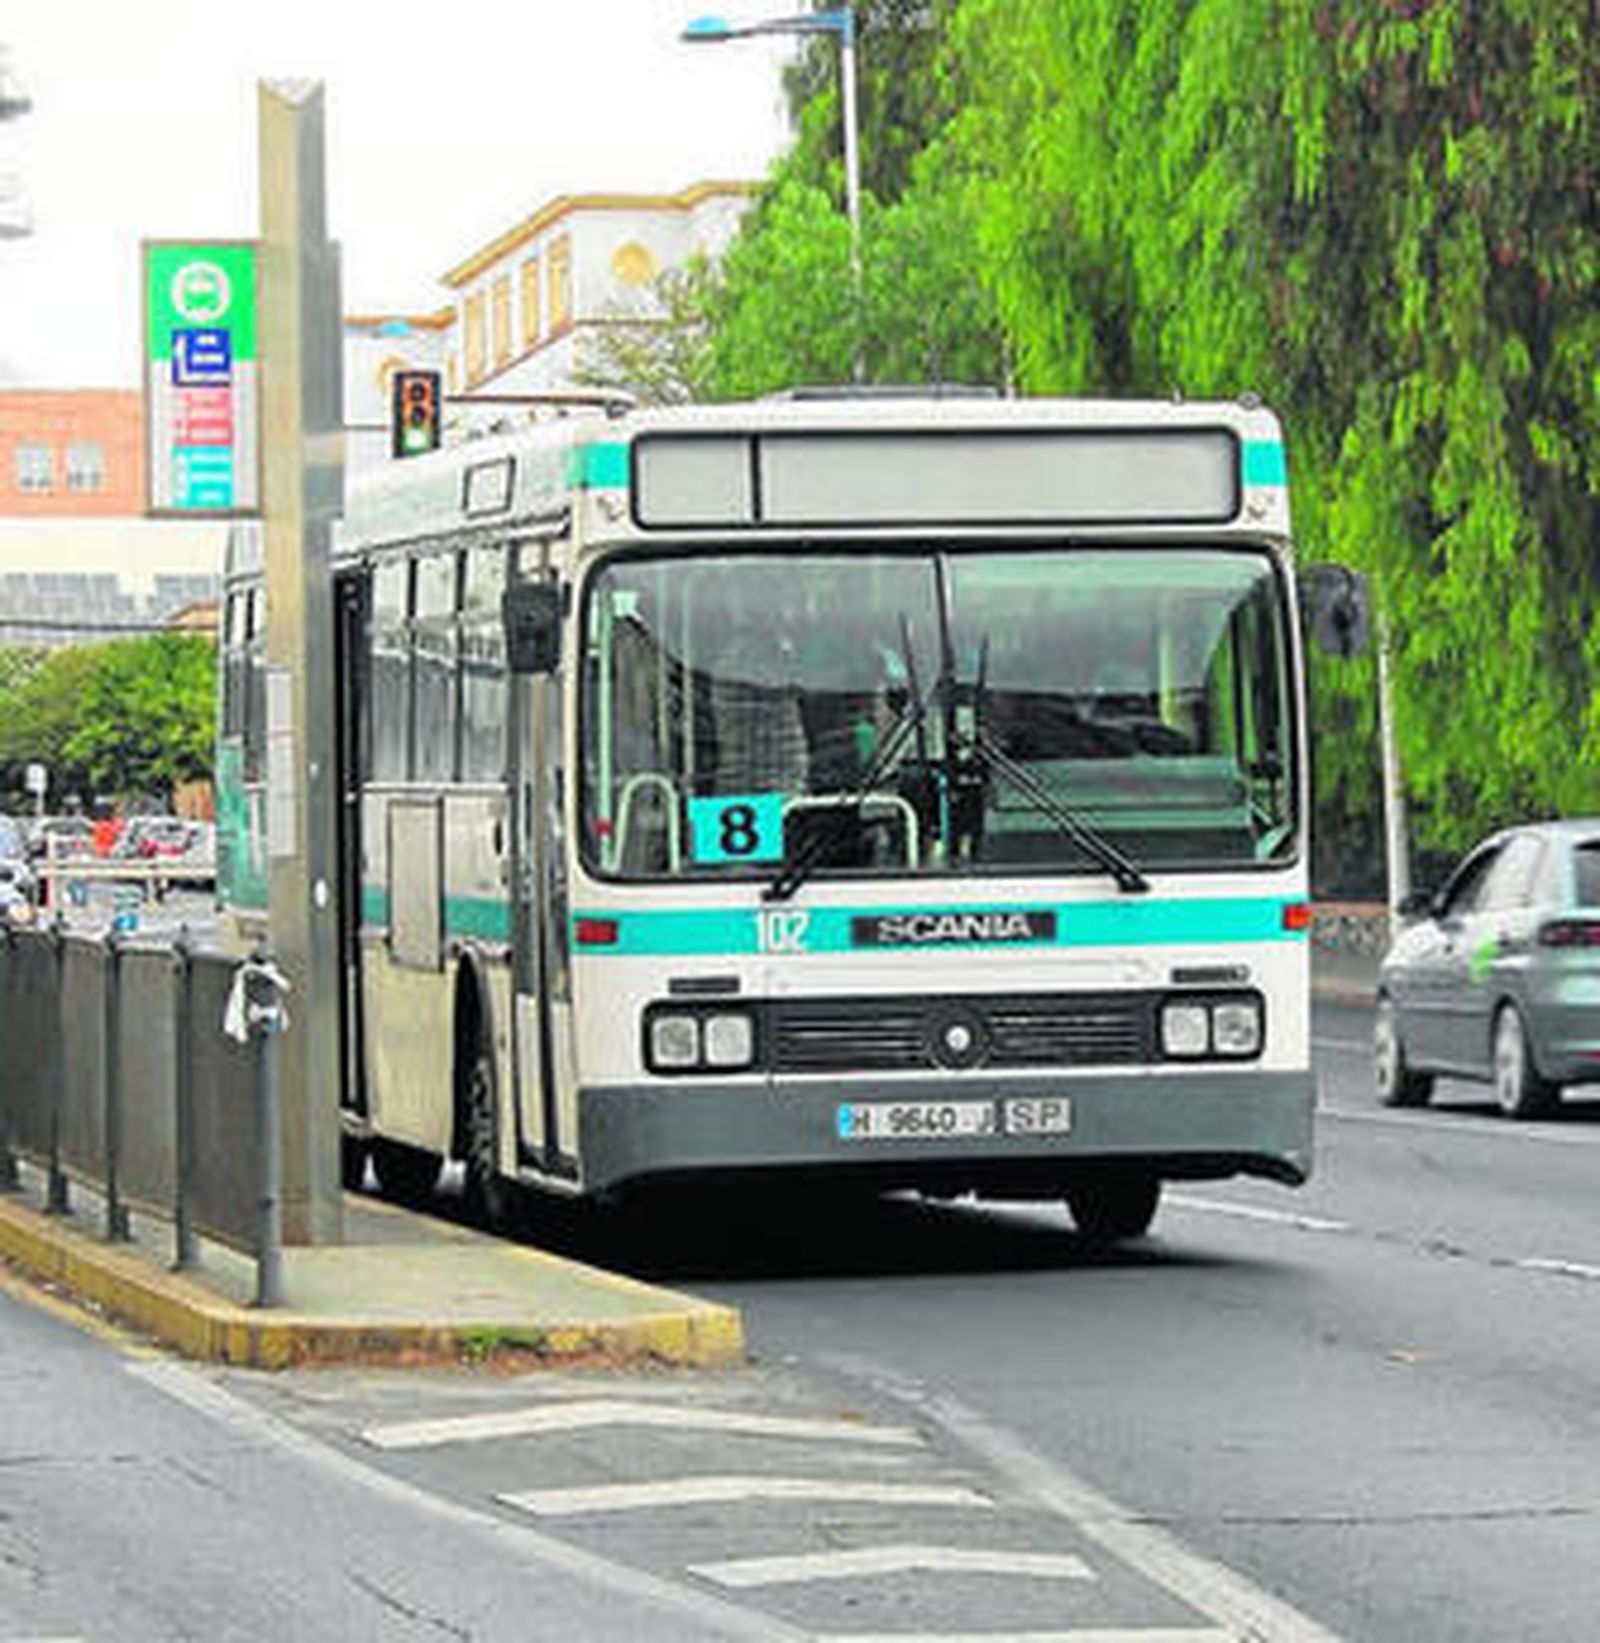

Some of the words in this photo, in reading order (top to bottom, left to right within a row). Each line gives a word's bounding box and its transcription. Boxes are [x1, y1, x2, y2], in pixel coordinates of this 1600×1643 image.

[720, 805, 758, 854] 8
[754, 911, 808, 951] 102
[878, 914, 1032, 942] SCANIA
